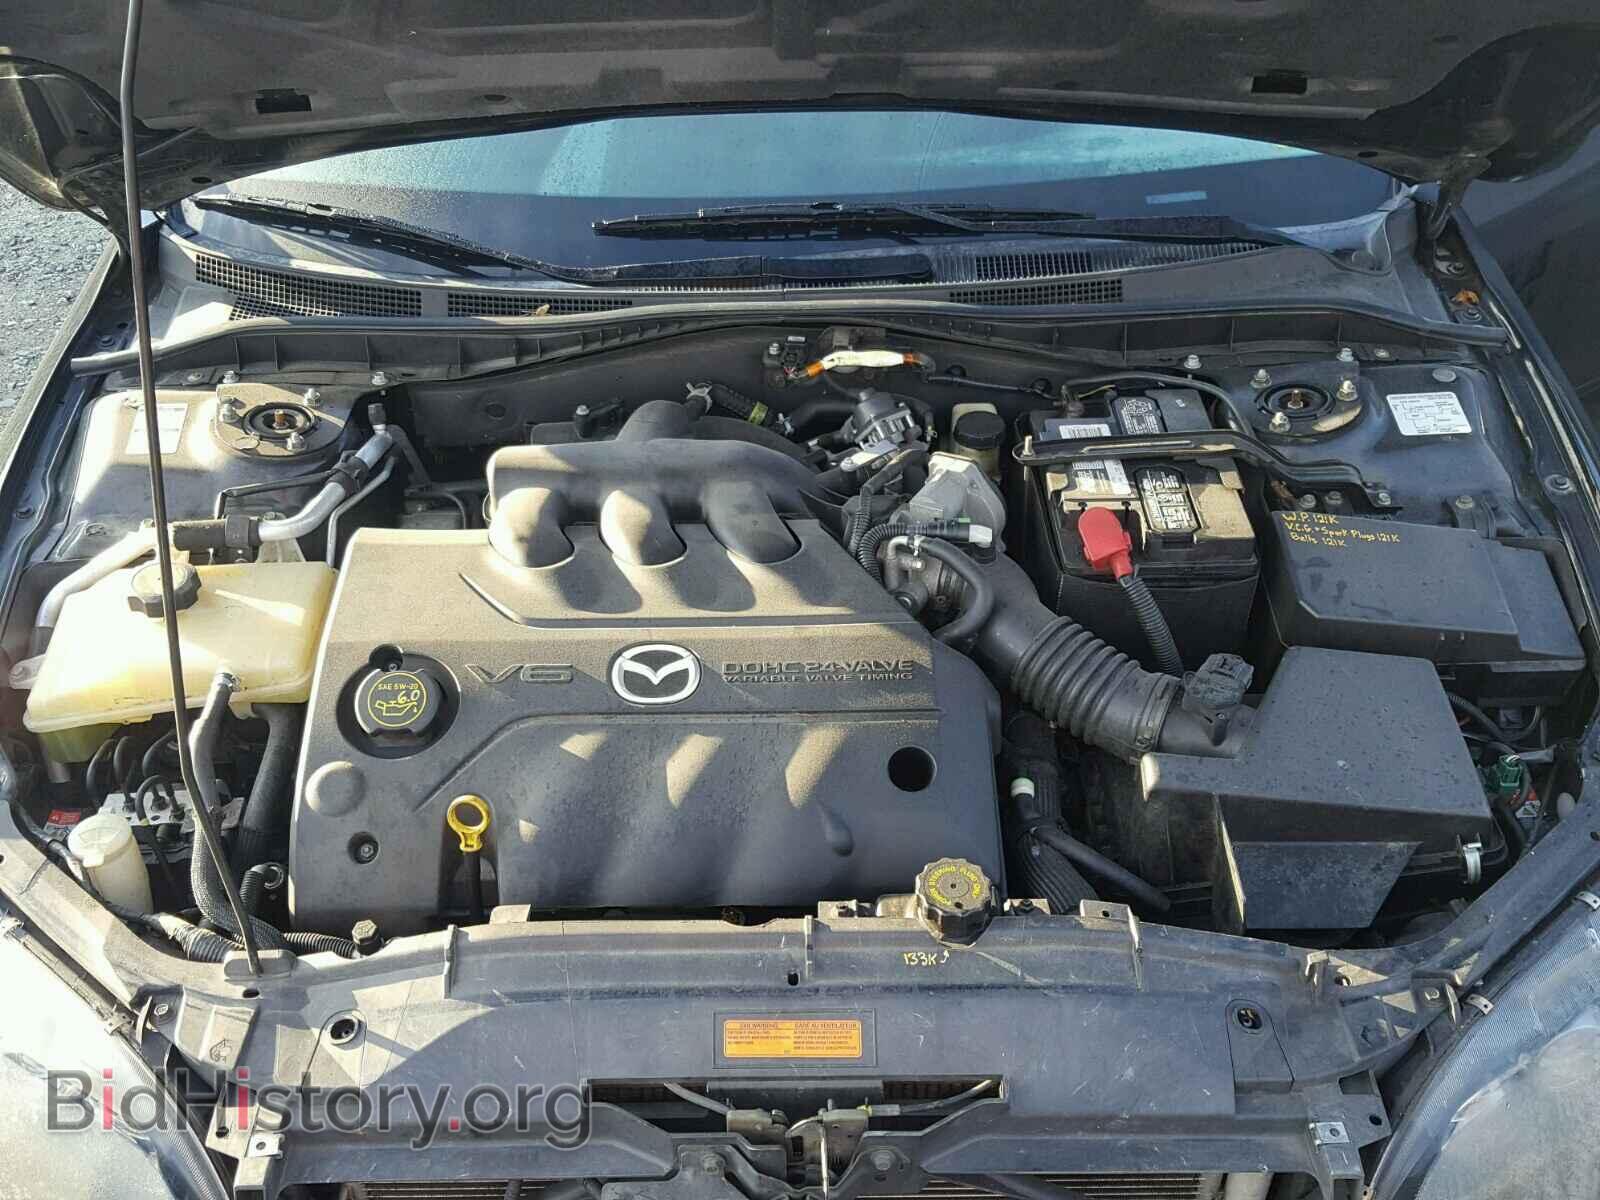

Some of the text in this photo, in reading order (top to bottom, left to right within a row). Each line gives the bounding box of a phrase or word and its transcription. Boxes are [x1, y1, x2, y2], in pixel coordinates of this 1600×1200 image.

[1313, 514, 1339, 524] 121K
[1321, 537, 1345, 546] 121K
[1377, 532, 1400, 542] 121K
[722, 661, 800, 674] DOHC
[464, 663, 573, 684] V6
[722, 671, 913, 683] VARIABLE VALVE TIMING
[377, 683, 393, 691] SAE
[903, 951, 938, 966] 133K
